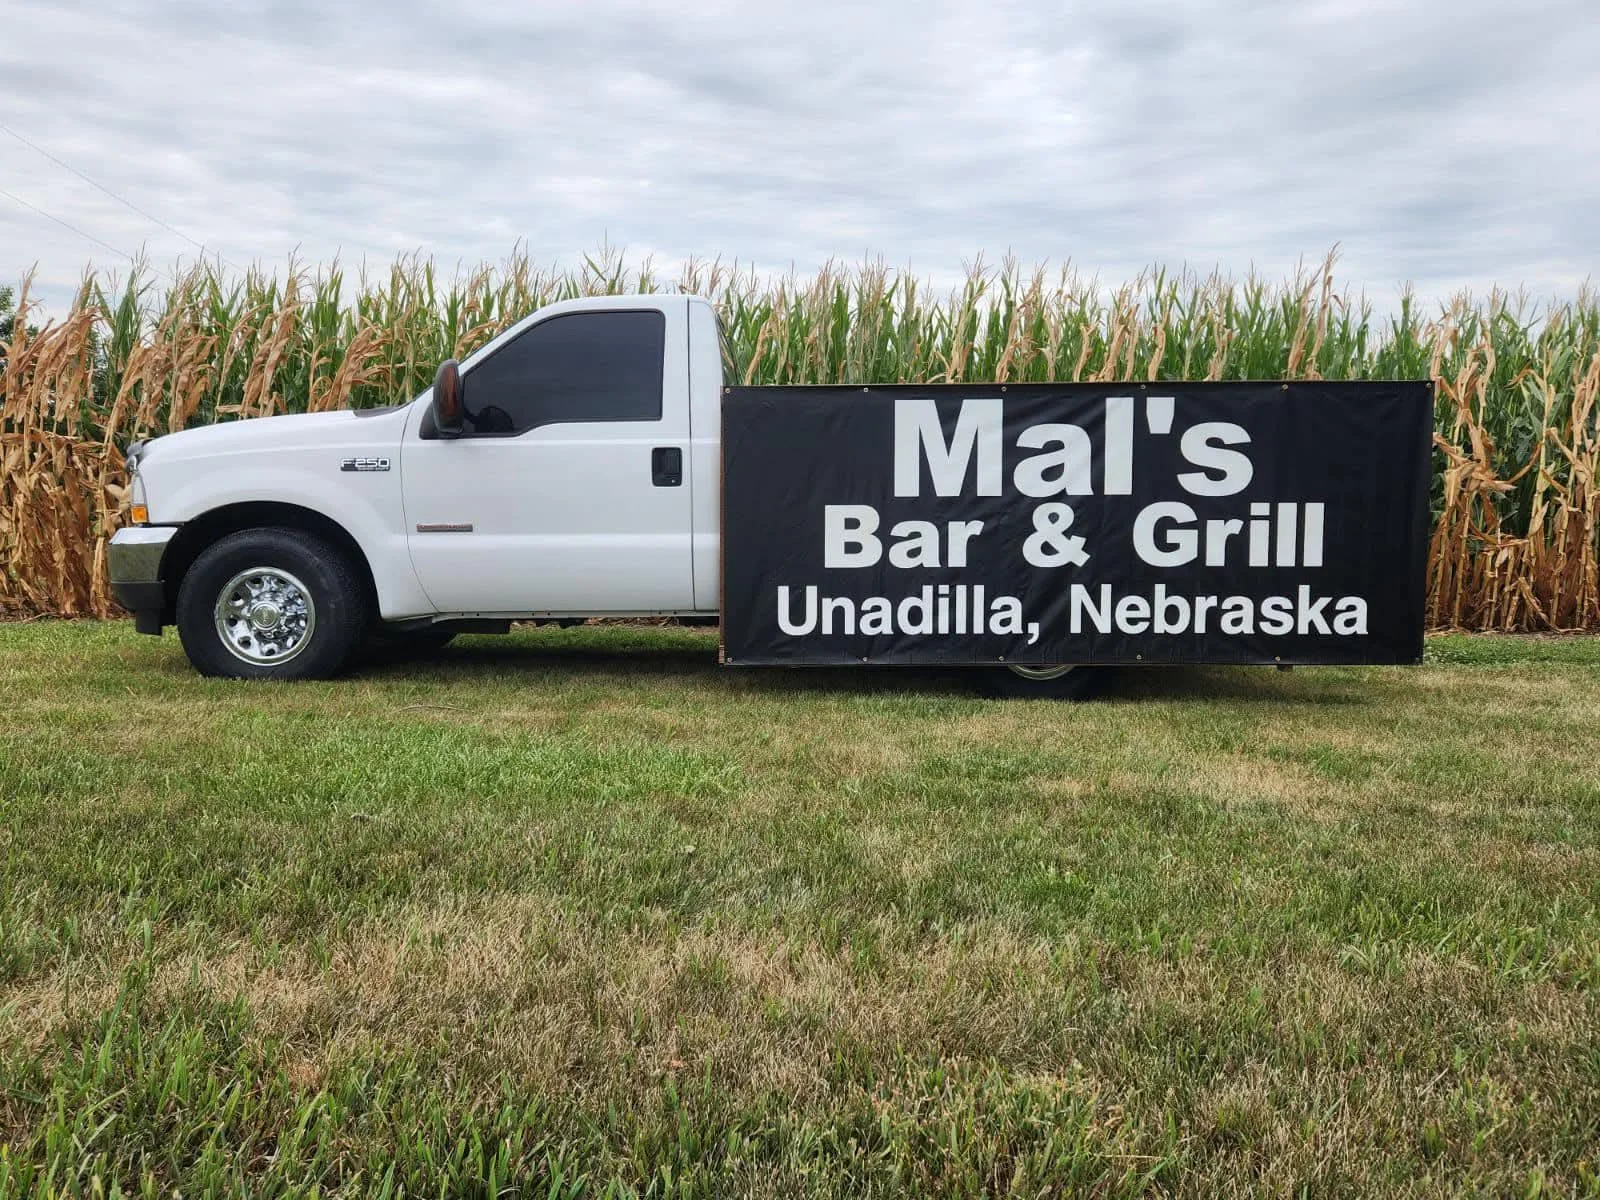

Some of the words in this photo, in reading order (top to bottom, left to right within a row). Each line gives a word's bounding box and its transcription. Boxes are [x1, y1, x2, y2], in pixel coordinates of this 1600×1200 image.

[894, 397, 1254, 498] Mal's
[824, 504, 985, 569] Bar
[1022, 502, 1091, 568] &
[1133, 501, 1325, 568] Grill
[777, 584, 1040, 645] Unadilla,
[1070, 584, 1369, 635] Nebraska
